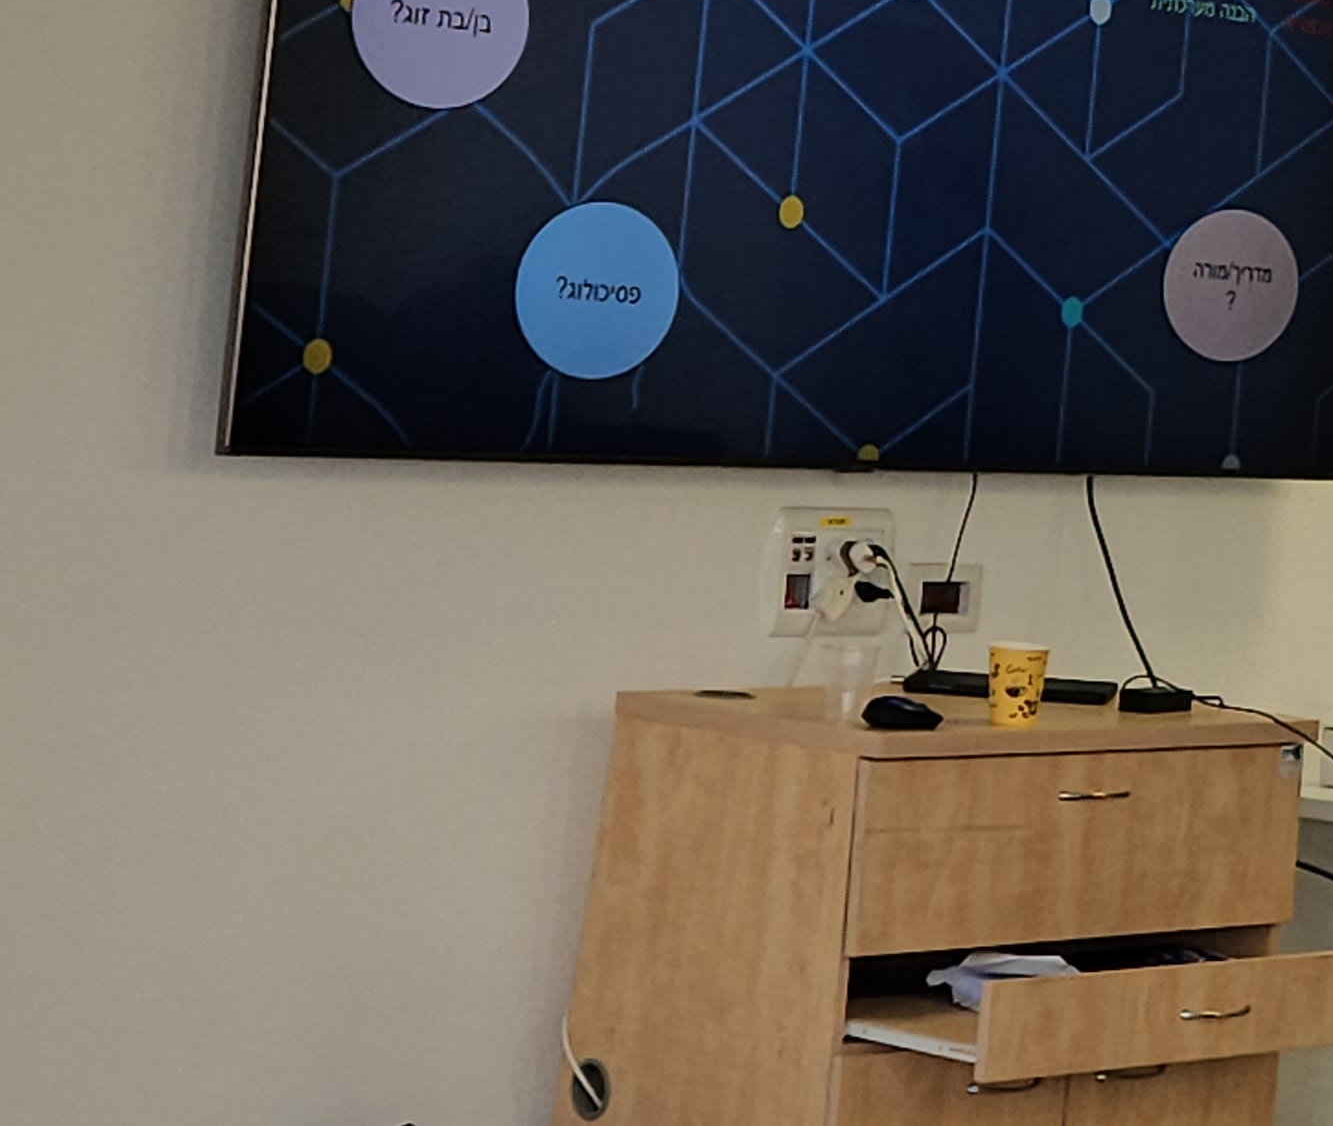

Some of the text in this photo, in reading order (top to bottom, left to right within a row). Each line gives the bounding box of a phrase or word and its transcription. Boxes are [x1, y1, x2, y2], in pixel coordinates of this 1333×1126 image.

[437, 7, 491, 37] בן/בת
[556, 275, 642, 304] פסיכולוג?
[1226, 290, 1237, 311] ?
